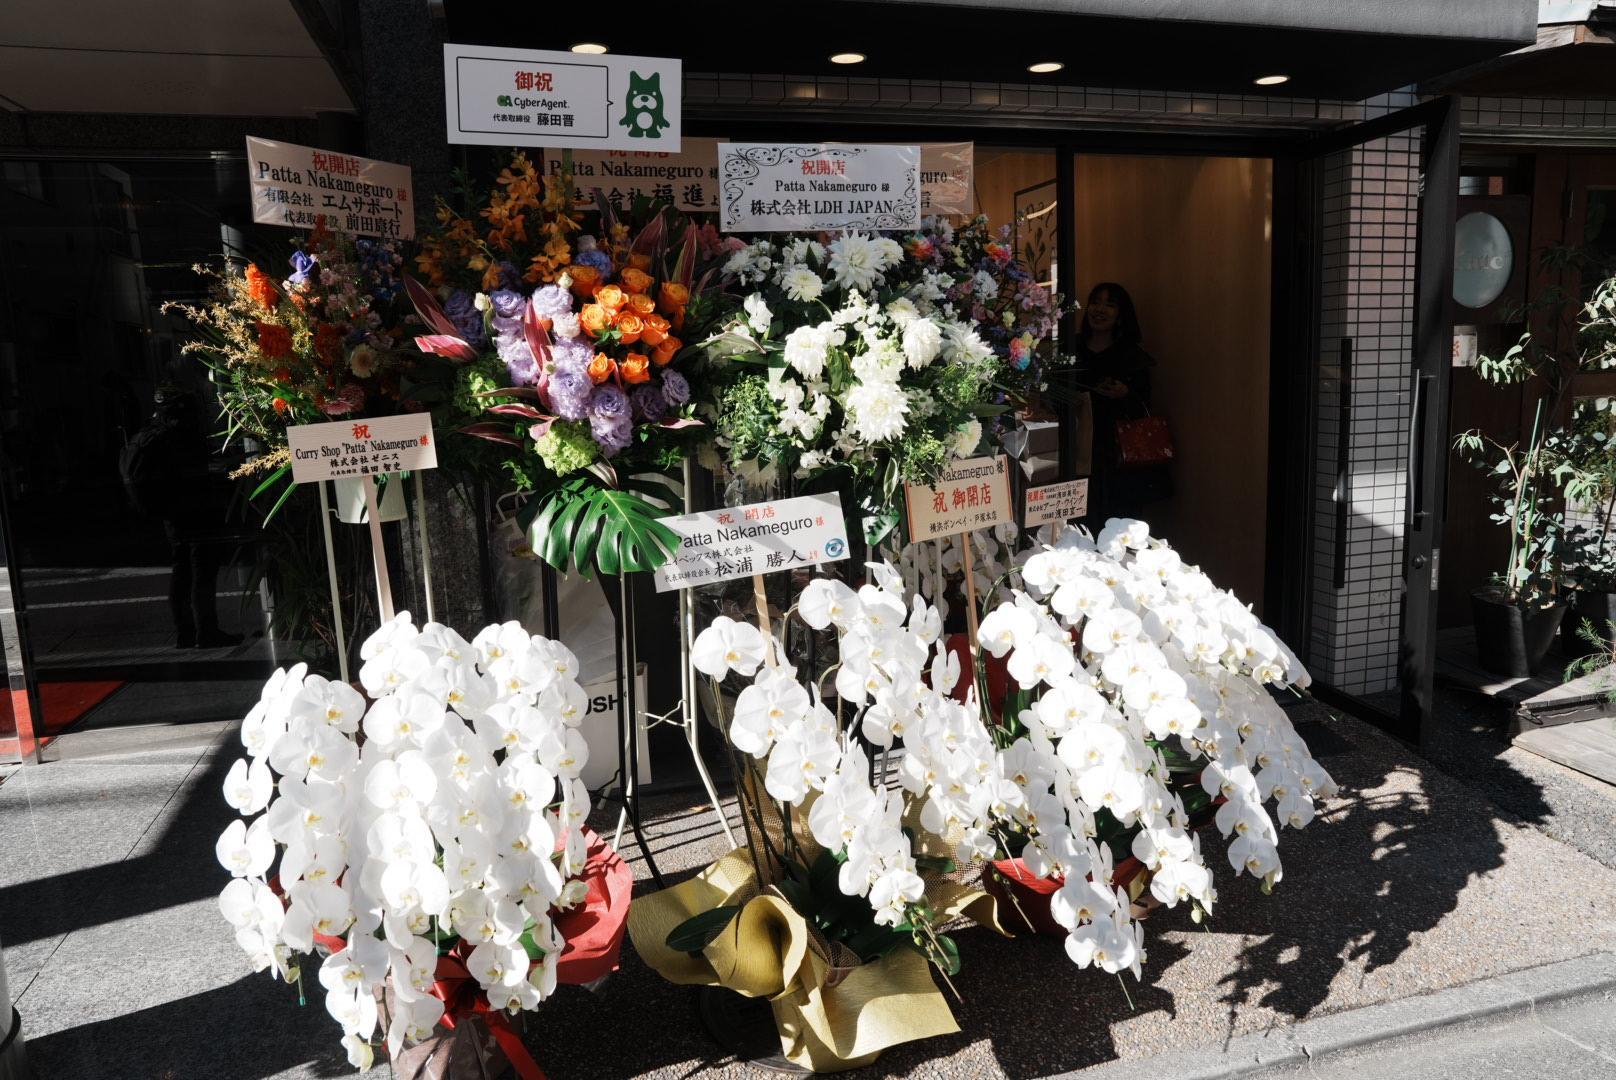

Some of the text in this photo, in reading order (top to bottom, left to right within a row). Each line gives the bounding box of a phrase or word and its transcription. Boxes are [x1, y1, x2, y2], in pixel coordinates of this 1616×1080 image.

[515, 70, 553, 92] 御祝
[493, 112, 575, 127] 代表取締役 藤田晋
[312, 151, 360, 177] 祝開店
[549, 160, 594, 177] Ptta
[600, 160, 704, 180] Nakameguro
[801, 159, 846, 176] 祝開店
[257, 161, 302, 184] Patta
[307, 169, 393, 199] Nakameguro
[775, 180, 805, 192] Patta
[809, 180, 877, 193] Nakameguro
[264, 187, 403, 219] 有限会社 エムサポート
[847, 200, 893, 215] JAPAN
[352, 423, 371, 440] 祝
[295, 448, 319, 460] Curry
[321, 445, 341, 457] Shop
[371, 438, 418, 451] Nakameguro
[419, 434, 429, 446] 様
[677, 532, 712, 548] atta
[717, 517, 813, 542] Nakameguro
